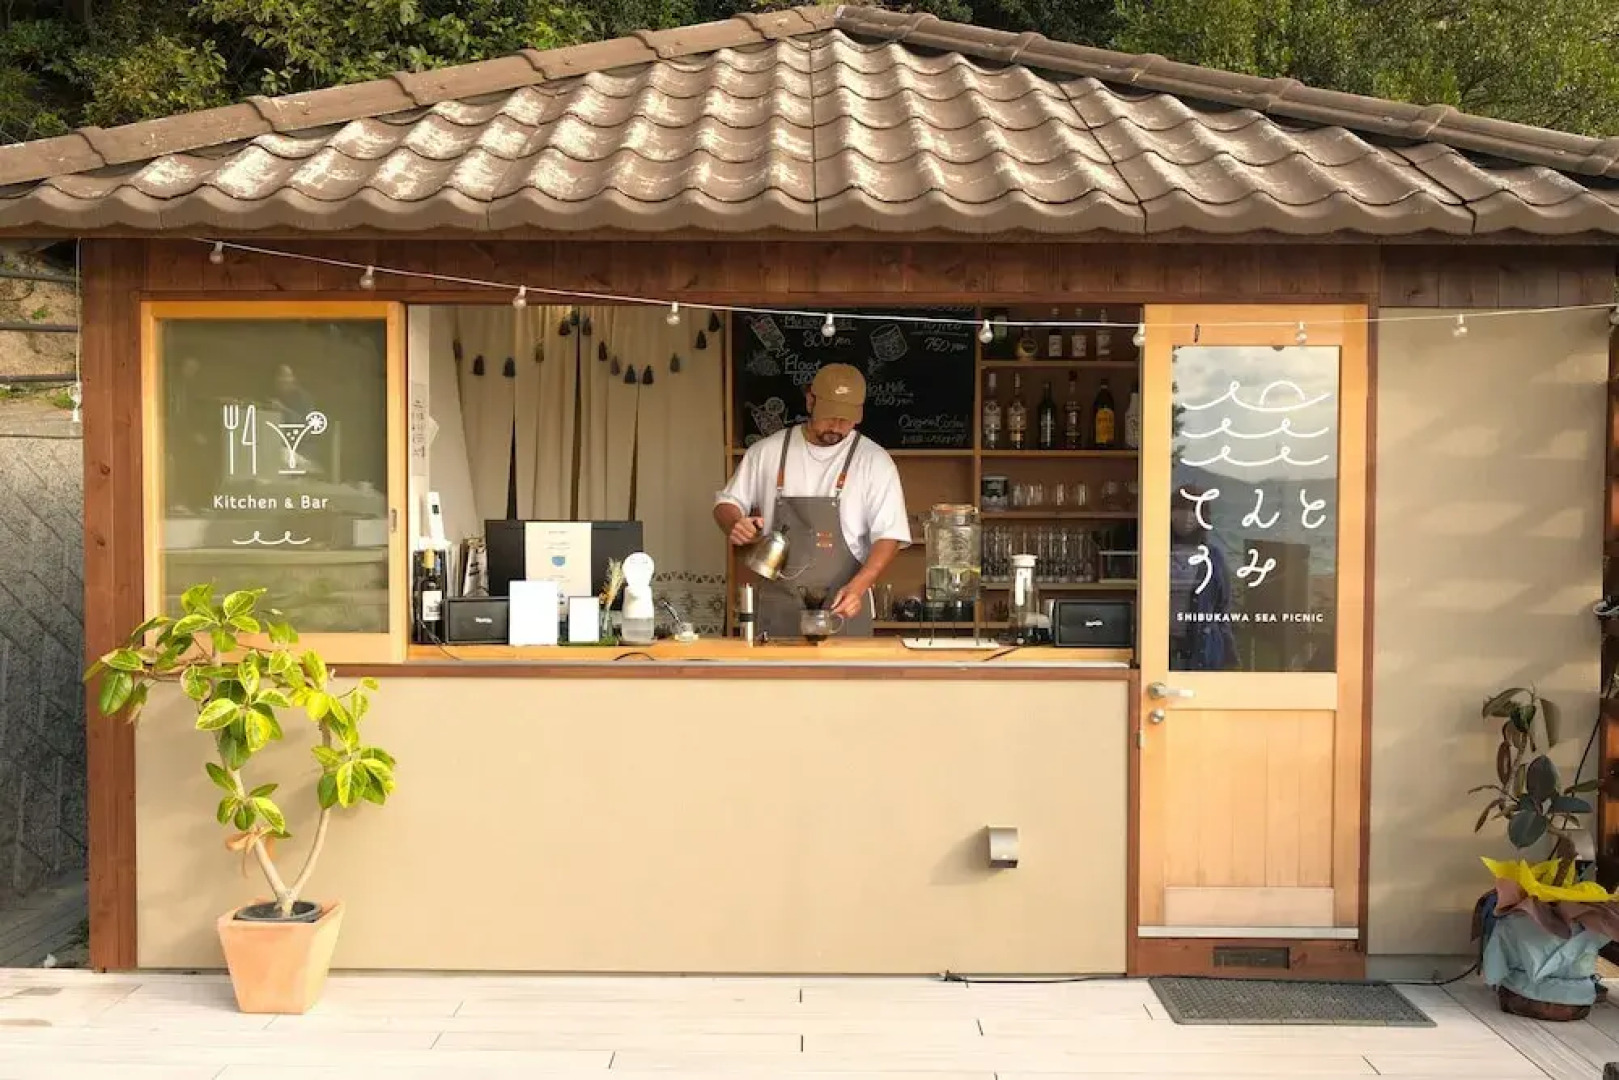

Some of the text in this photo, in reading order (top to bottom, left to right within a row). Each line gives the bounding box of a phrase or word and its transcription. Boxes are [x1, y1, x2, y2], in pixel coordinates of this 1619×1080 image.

[803, 330, 833, 348] 800
[785, 353, 822, 371] Float
[213, 494, 329, 510] Kitchen & Bar
[1176, 612, 1324, 623] SHIBUKAWA SEA PICNIC
